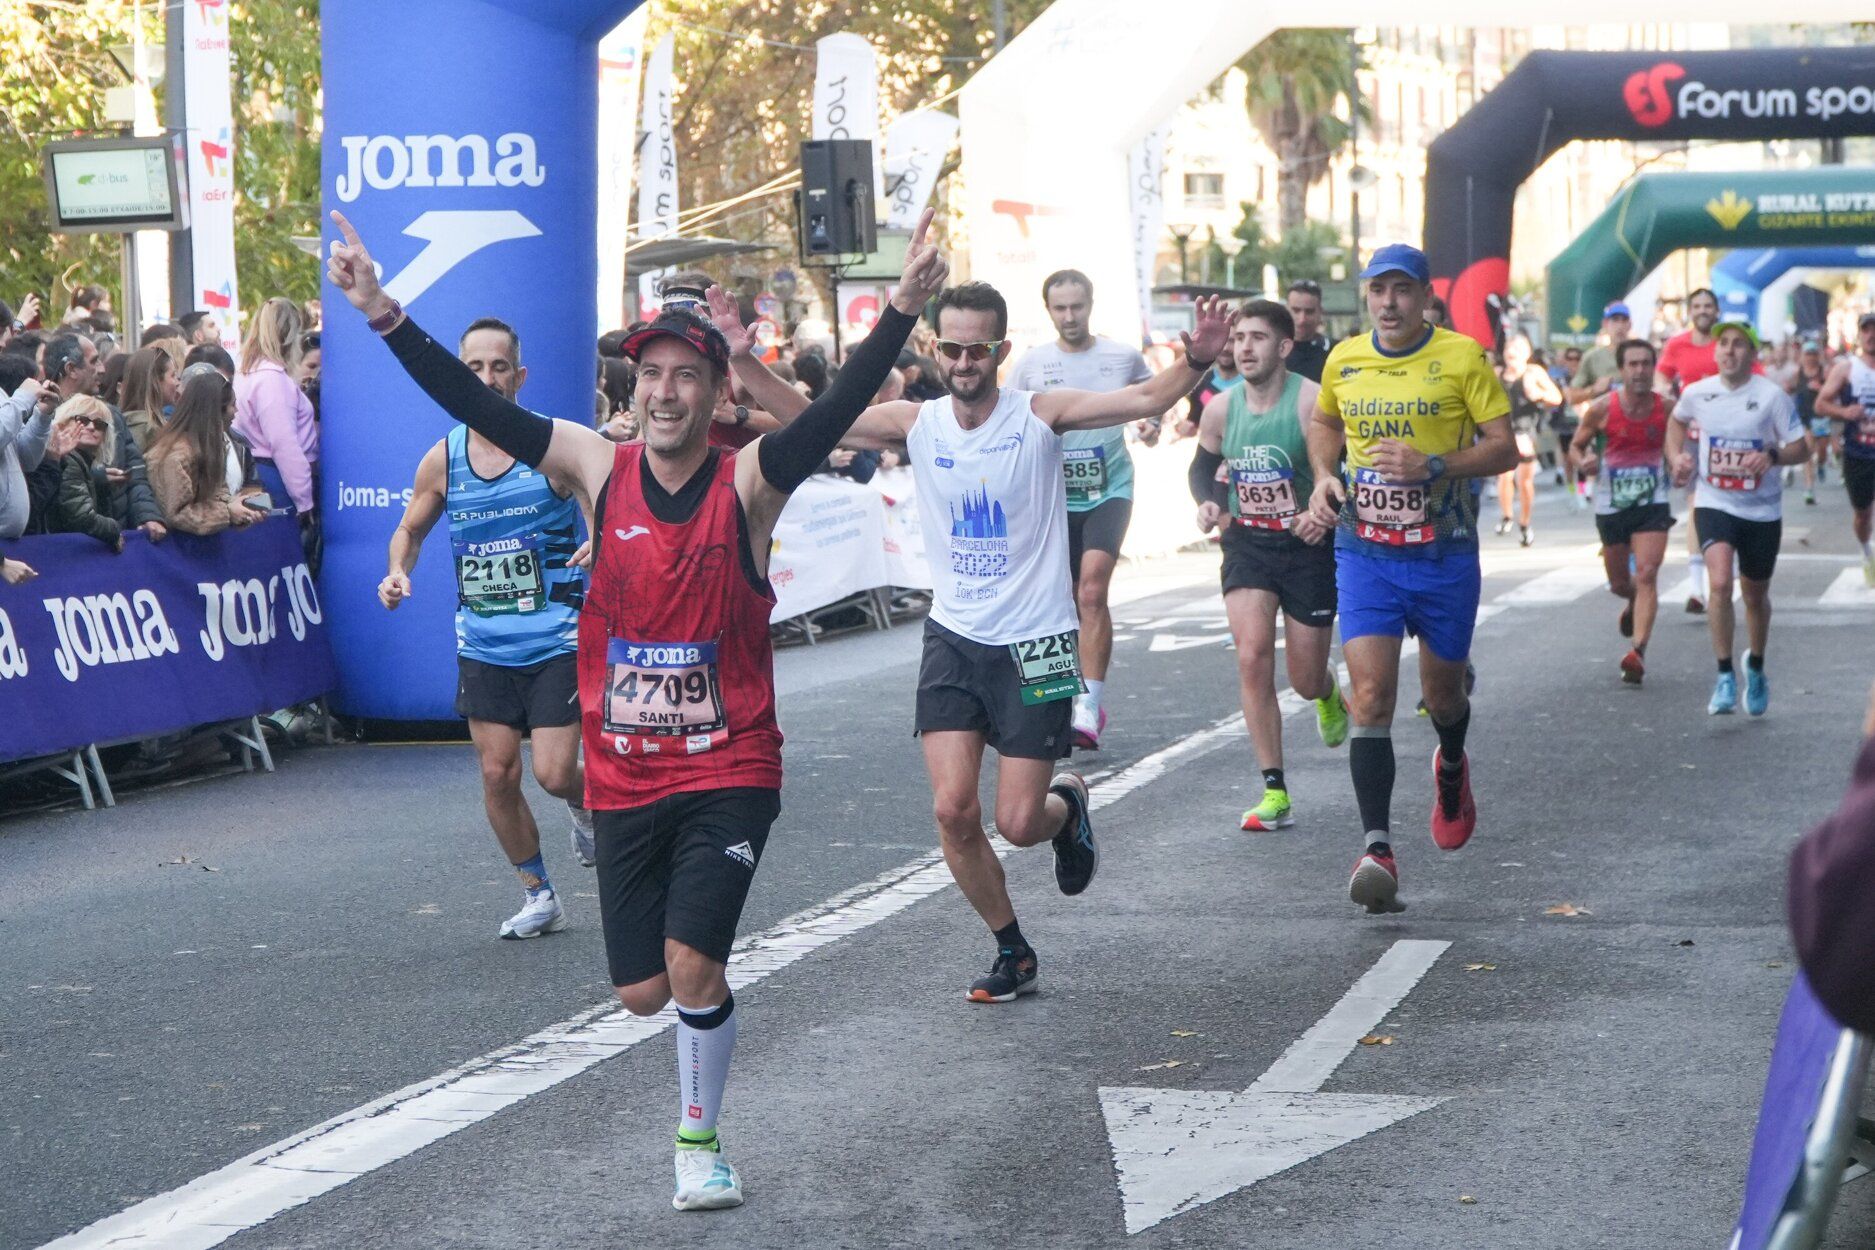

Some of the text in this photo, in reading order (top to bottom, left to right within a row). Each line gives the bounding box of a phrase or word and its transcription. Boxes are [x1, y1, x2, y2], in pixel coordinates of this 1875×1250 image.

[1678, 81, 1875, 121] forum spo
[1342, 397, 1440, 417] Valdizarbe
[1358, 420, 1415, 438] GANA
[1240, 483, 1289, 504] 3631
[1358, 487, 1422, 511] 3058
[1377, 514, 1403, 523] RAUL
[951, 538, 1009, 552] BARCELONA
[463, 554, 533, 582] 2118
[952, 551, 1007, 577] 2022
[482, 582, 518, 592] CHECA
[613, 671, 709, 707] 4709
[638, 712, 685, 725] SANTI
[692, 1036, 700, 1105] COMPRESSPORT
